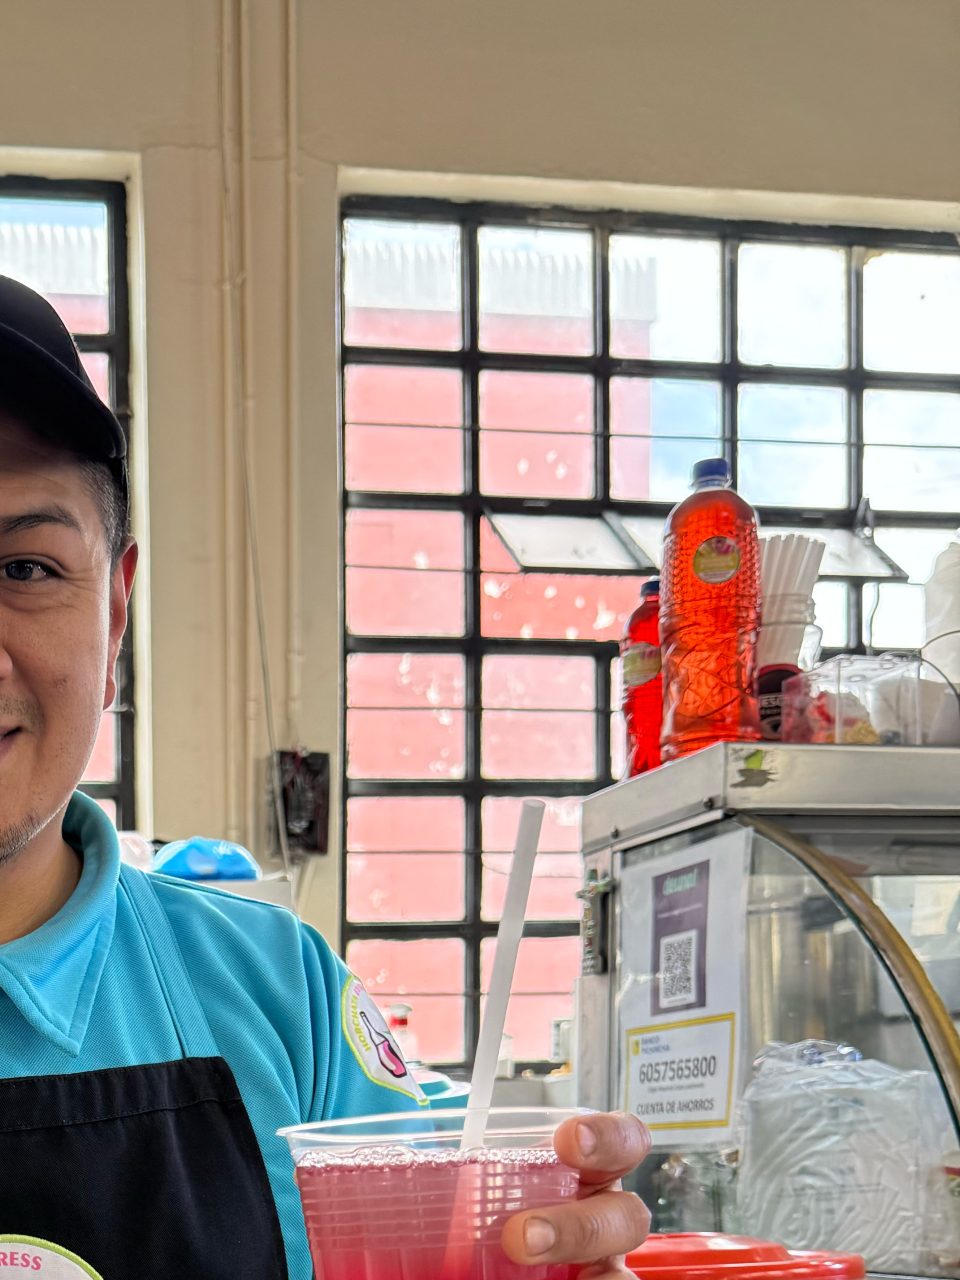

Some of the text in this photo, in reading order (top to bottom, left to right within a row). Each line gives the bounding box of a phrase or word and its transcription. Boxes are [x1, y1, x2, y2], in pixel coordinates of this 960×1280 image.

[639, 1056, 716, 1083] 6057565800
[636, 1101, 664, 1115] CUENTA
[666, 1100, 675, 1114] DE
